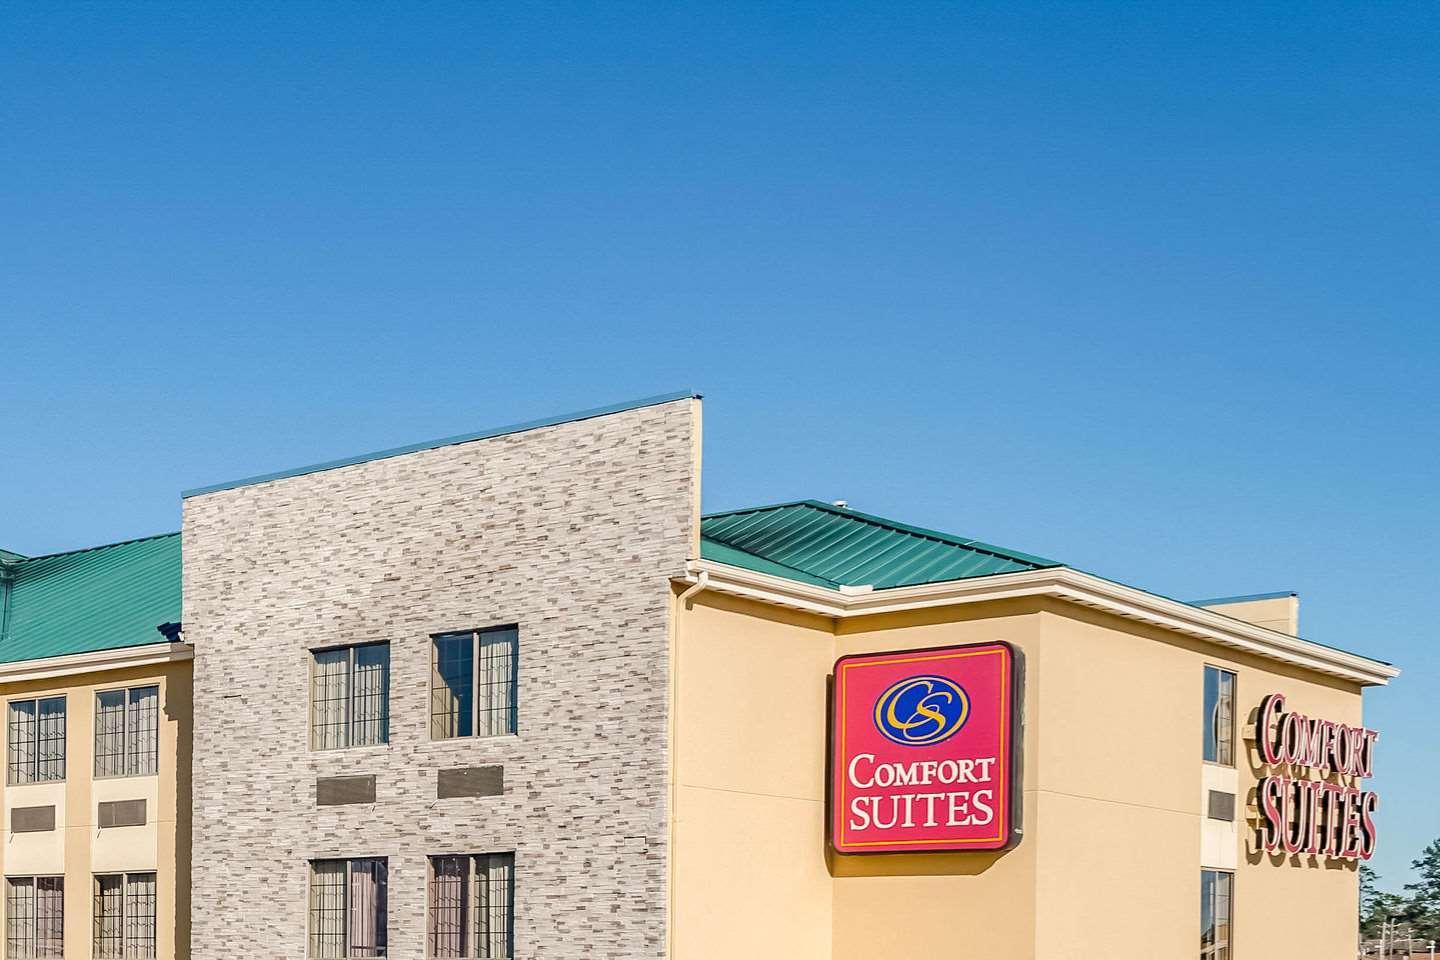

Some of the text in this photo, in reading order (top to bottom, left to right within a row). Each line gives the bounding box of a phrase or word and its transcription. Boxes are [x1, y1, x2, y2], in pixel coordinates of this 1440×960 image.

[1261, 692, 1379, 778] COMFORT
[848, 753, 996, 788] COMFORT
[849, 789, 994, 831] SUITES
[1261, 775, 1378, 860] SUITES
